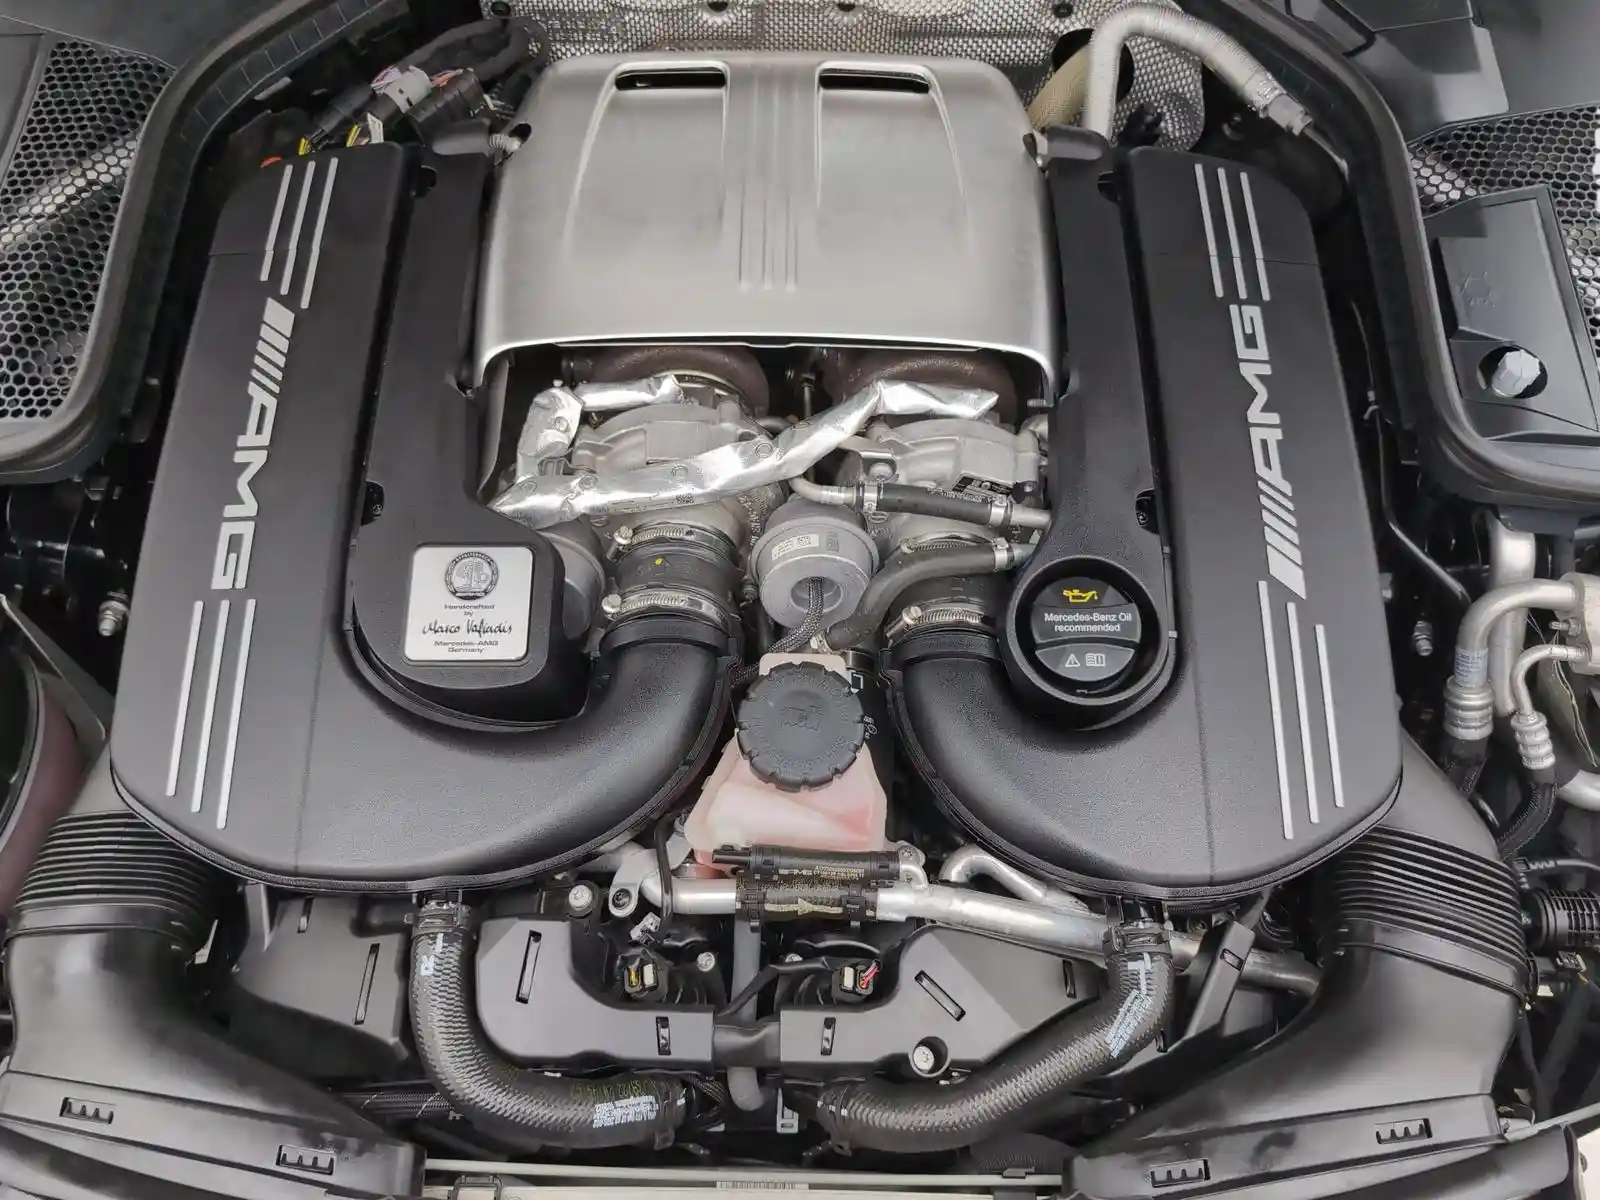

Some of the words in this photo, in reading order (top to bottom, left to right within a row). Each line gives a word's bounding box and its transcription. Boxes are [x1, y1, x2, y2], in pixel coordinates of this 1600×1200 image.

[1229, 304, 1293, 497] AMG
[211, 381, 278, 590] AMG
[1044, 612, 1117, 622] Mercedes-Benz
[1118, 612, 1132, 622] Oil
[1054, 623, 1121, 632] recommended
[448, 646, 484, 654] Germany
